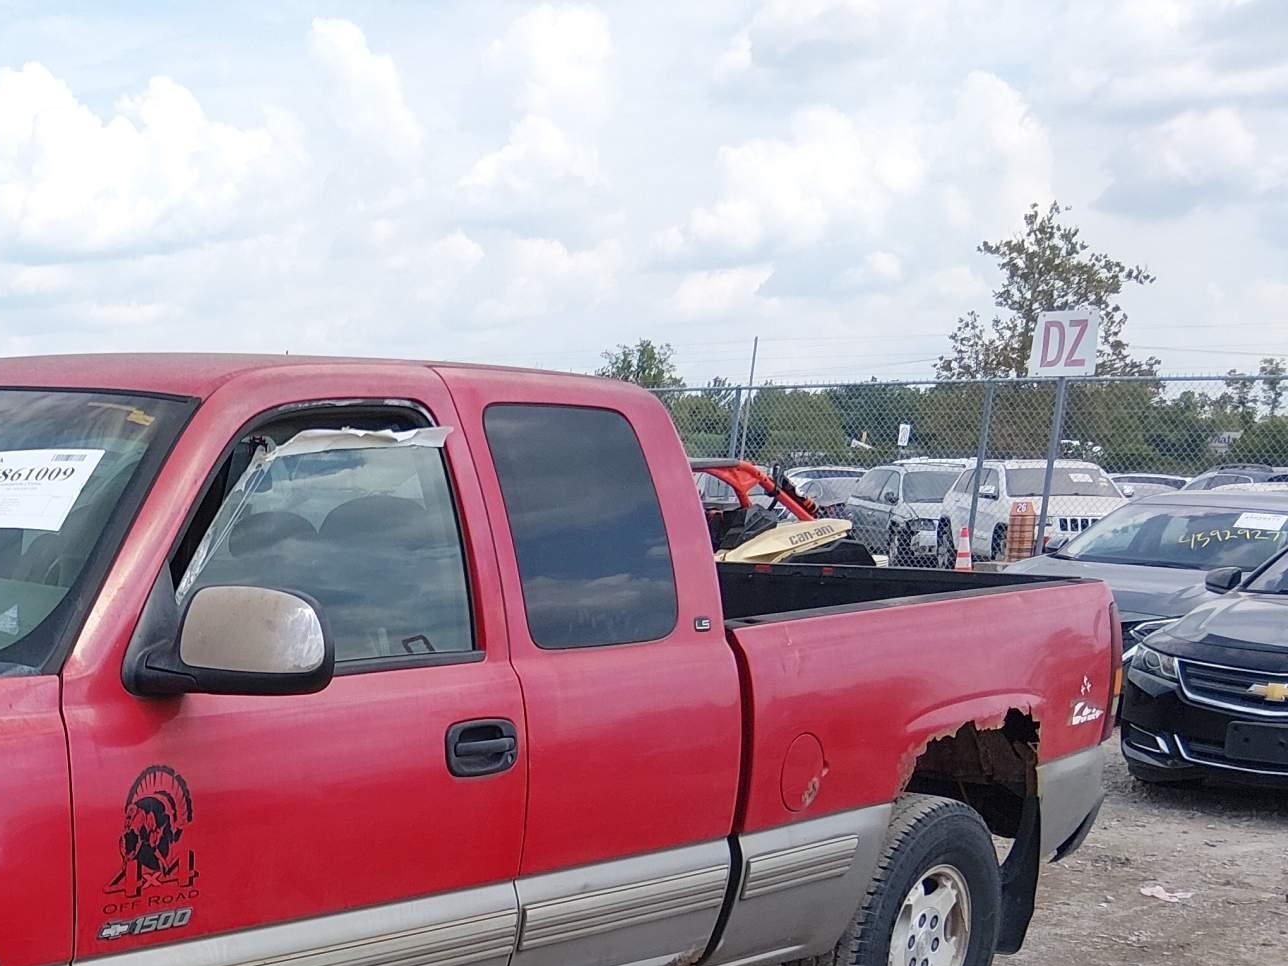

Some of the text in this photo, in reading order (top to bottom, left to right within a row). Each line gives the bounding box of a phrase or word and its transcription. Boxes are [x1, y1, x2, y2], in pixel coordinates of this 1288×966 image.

[1040, 318, 1089, 368] DZ
[788, 525, 835, 545] can-am
[695, 619, 711, 630] LS
[102, 889, 200, 914] OFF ROAD
[132, 906, 192, 935] 1500
